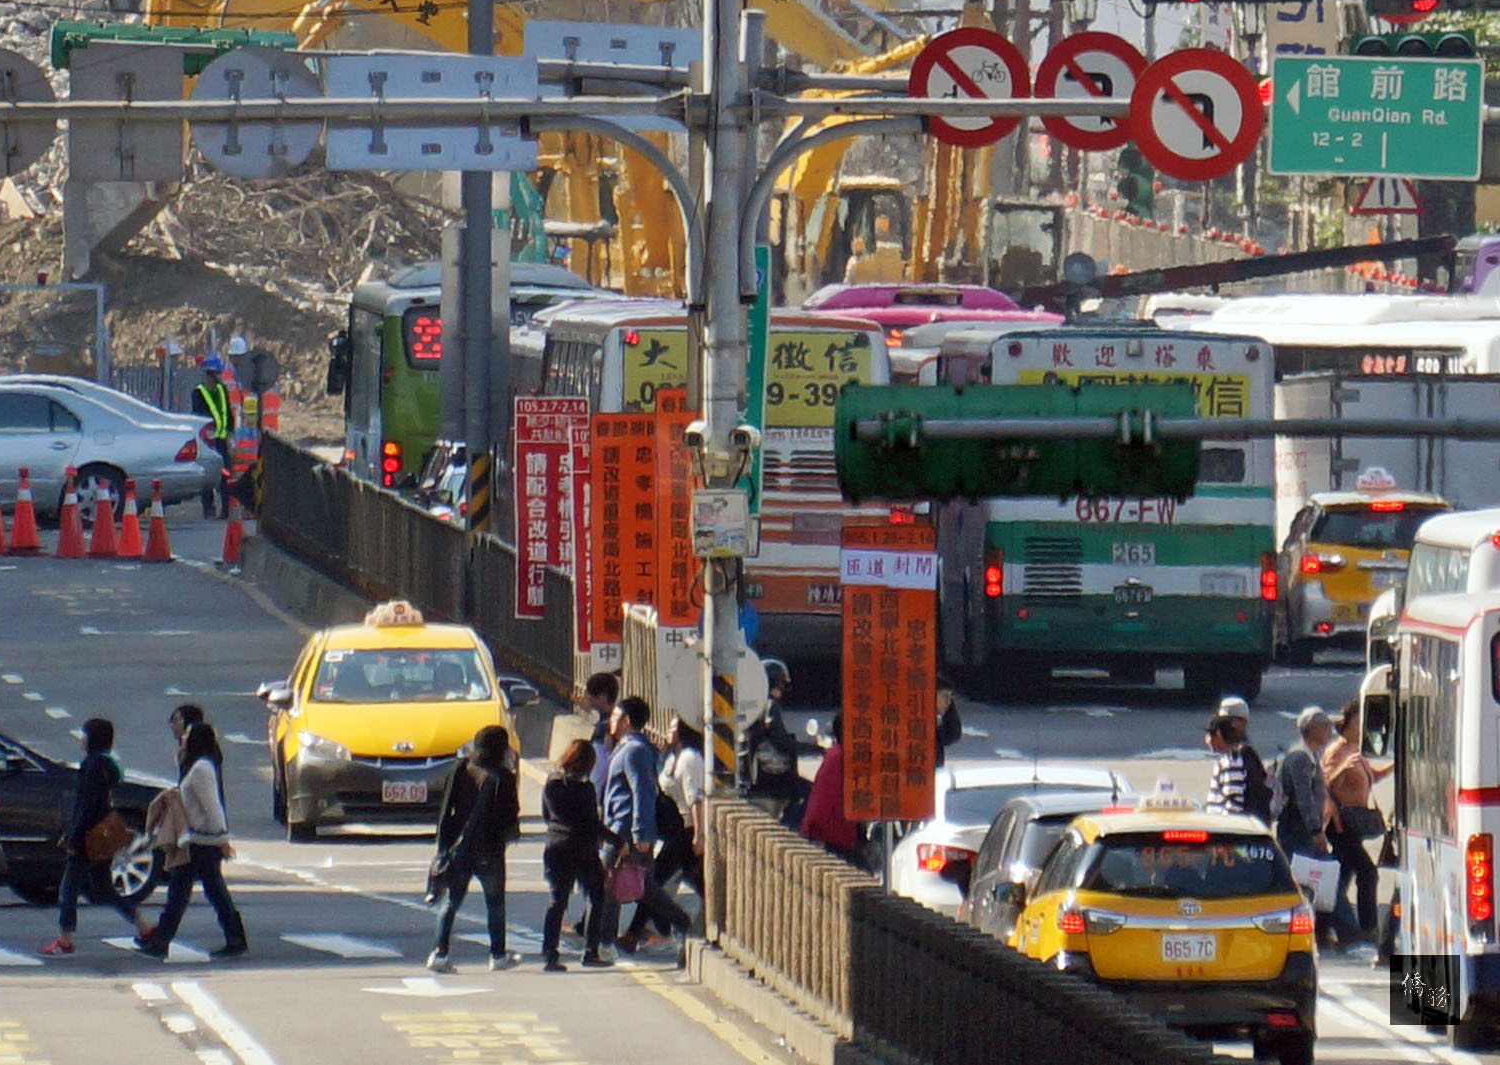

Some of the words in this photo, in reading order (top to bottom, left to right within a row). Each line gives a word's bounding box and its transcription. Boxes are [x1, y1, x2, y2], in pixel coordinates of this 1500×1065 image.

[1306, 63, 1468, 102] 館前路
[1328, 107, 1412, 124] GuanQian
[1052, 344, 1216, 370] 歡迎搭乘
[518, 399, 586, 414] 105.2.7-2.14
[1113, 541, 1154, 564] 265
